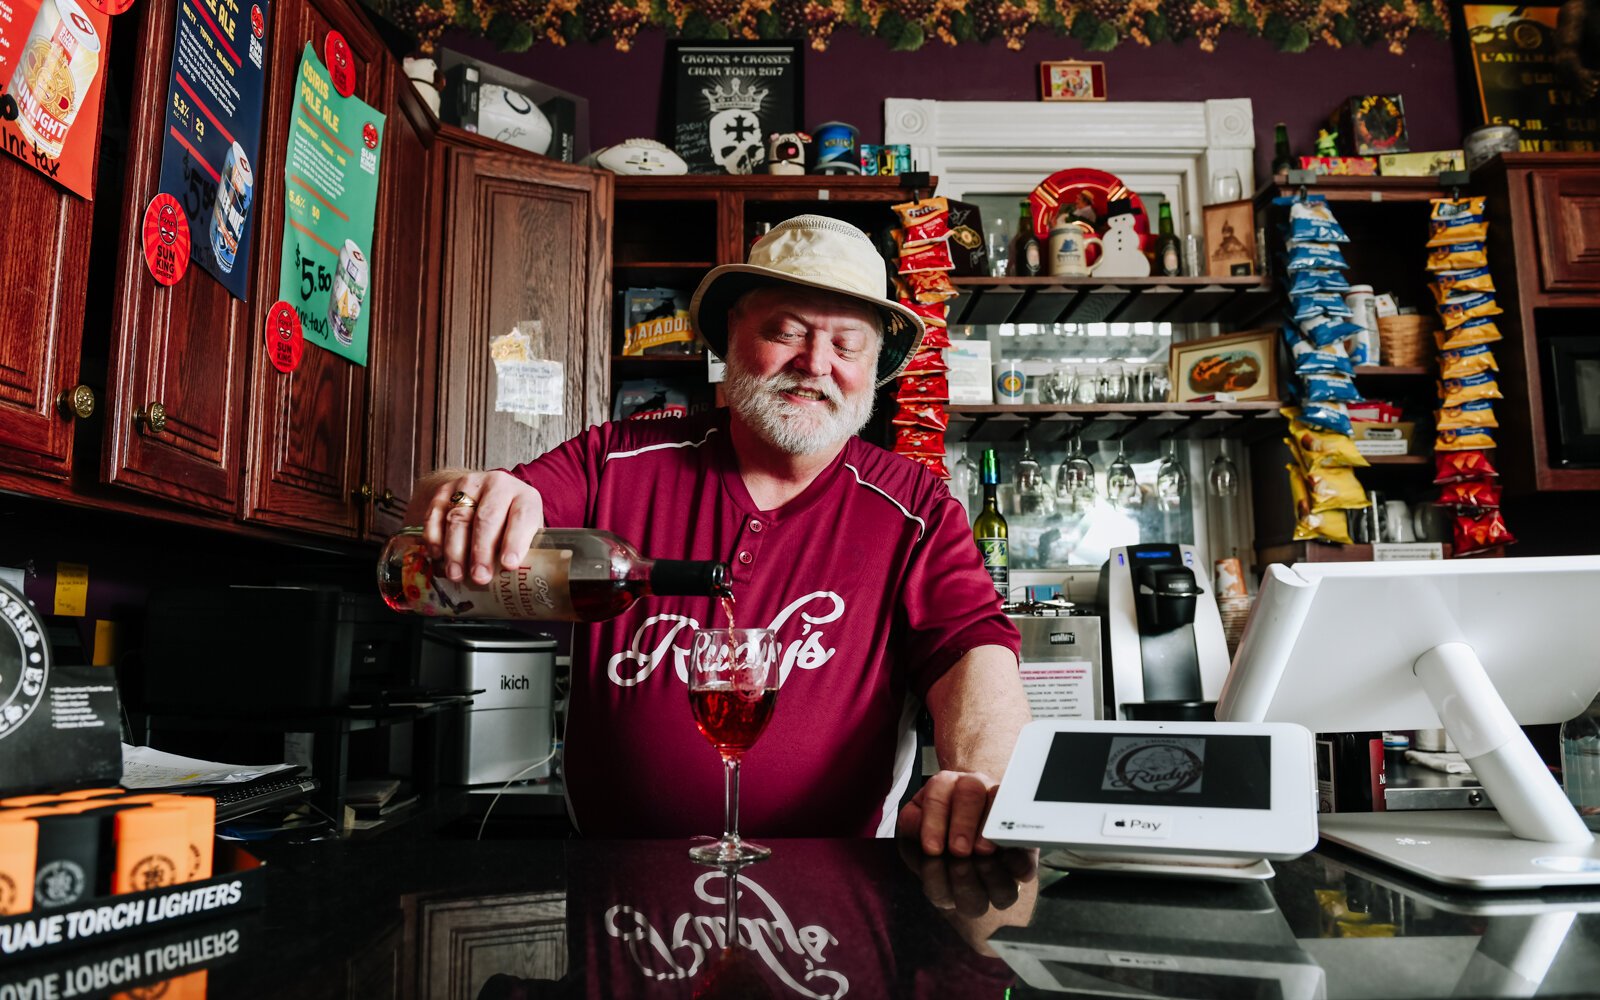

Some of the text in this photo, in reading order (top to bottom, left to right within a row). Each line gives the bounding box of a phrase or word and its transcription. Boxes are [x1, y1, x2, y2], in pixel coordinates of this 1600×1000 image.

[218, 4, 236, 42] ALE
[200, 25, 214, 50] TOFFEE
[250, 34, 262, 56] SUN
[682, 54, 730, 64] CROWNS
[742, 54, 791, 64] CROSSES
[303, 60, 329, 100] OSIRIS
[688, 67, 784, 76] CIGAR TOUR 2017
[174, 92, 205, 136] 5.3% 23
[302, 80, 339, 133] PALE ALE
[38, 128, 51, 140] ALE
[32, 140, 60, 178] tax
[361, 147, 376, 162] SUN
[289, 190, 305, 208] 5.6%
[157, 245, 175, 260] SUN
[156, 259, 174, 273] KING
[277, 341, 292, 353] SUN
[500, 570, 522, 618] UMMER
[518, 566, 536, 617] Indiana
[607, 591, 846, 690] Rudy's
[1050, 632, 1075, 644] SUMMIT
[500, 675, 529, 690] ikich
[1130, 819, 1162, 831] Pay
[66, 900, 144, 940] TORCH
[146, 880, 242, 923] LIGHTERS
